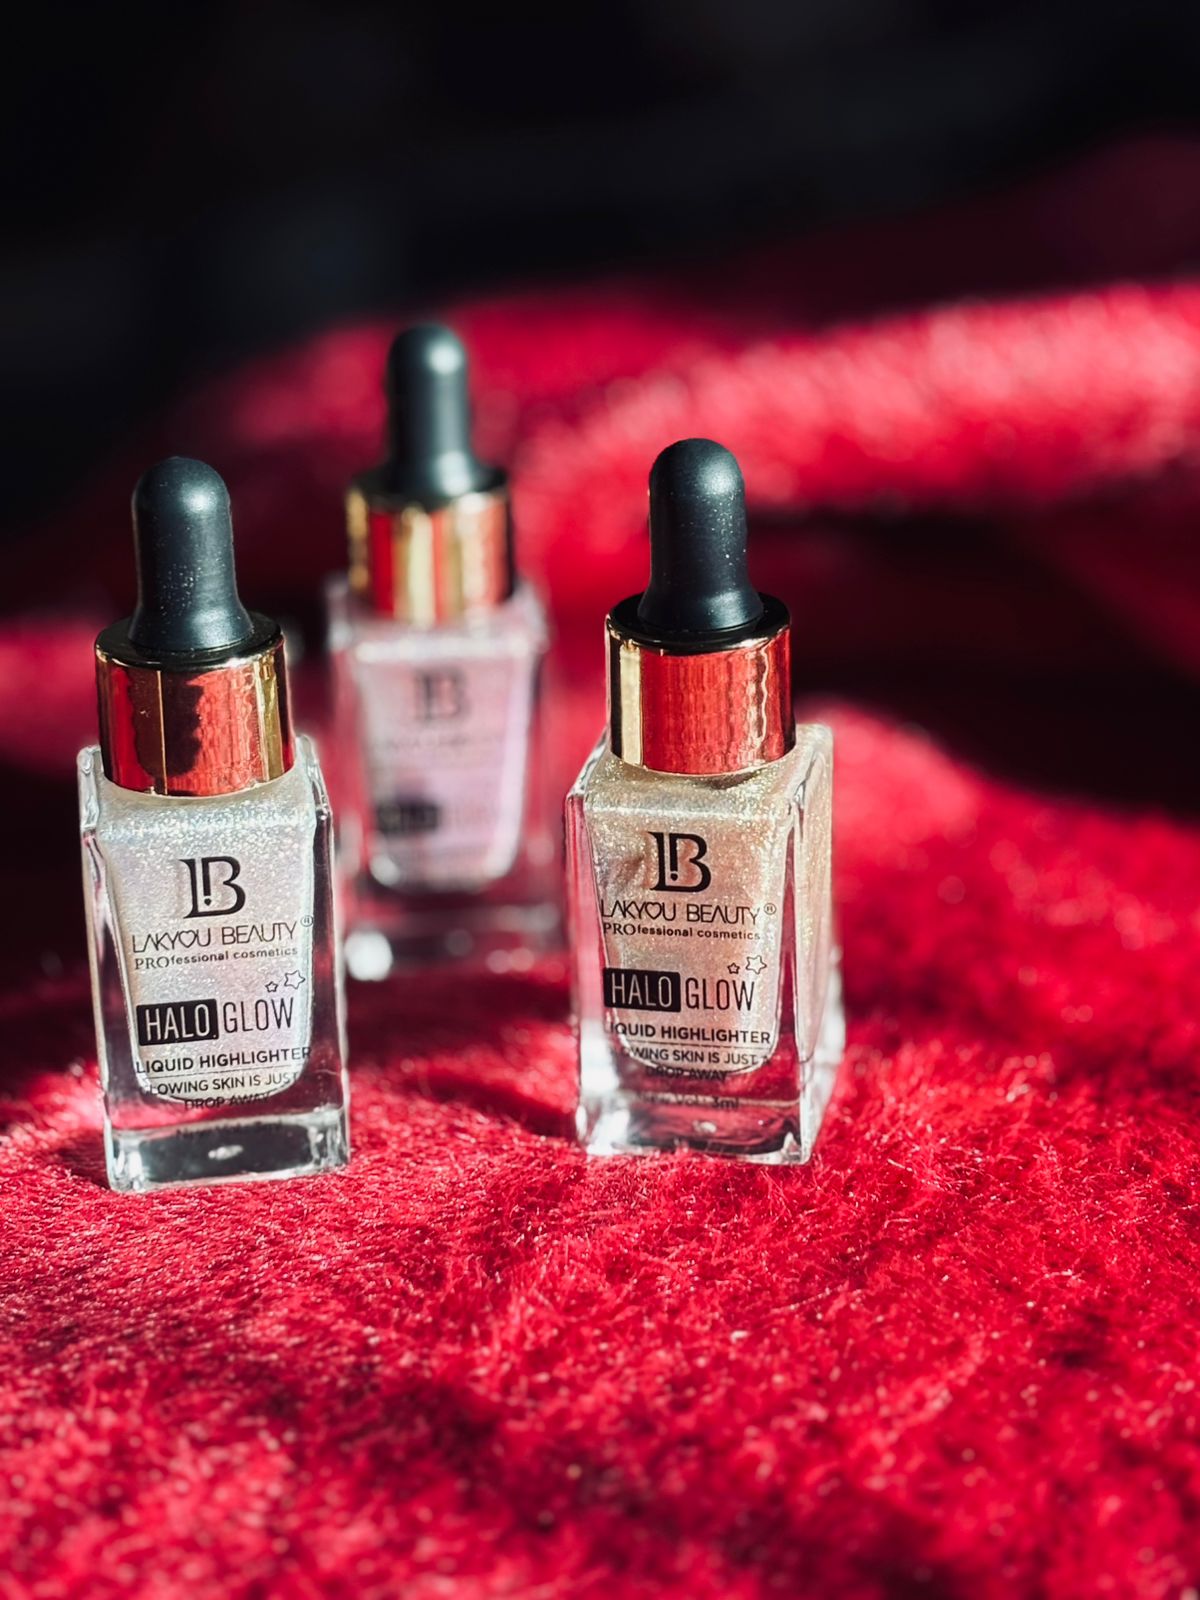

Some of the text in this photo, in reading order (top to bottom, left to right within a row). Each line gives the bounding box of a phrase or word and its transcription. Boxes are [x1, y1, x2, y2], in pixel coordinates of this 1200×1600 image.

[600, 899, 676, 921] LAKYOU
[687, 903, 761, 925] BEAUTY
[132, 927, 211, 954] LAKYOU
[222, 921, 297, 946] BEAUTY
[602, 921, 761, 942] PROfessional cosmetics
[134, 946, 299, 970] PROfessional cosmetics
[610, 970, 755, 1012] HALO GLOW
[143, 997, 294, 1042] HALO GLOW
[607, 1022, 771, 1045] IQUID HIGHLIGHTER
[136, 1046, 312, 1074] LIQUID HIGHLIGHTER
[672, 1048, 705, 1063] SKIN
[708, 1050, 721, 1064] IS
[723, 1052, 759, 1067] JUST
[211, 1075, 245, 1091] SKIN
[248, 1073, 261, 1088] IS
[184, 1095, 226, 1111] DROP
